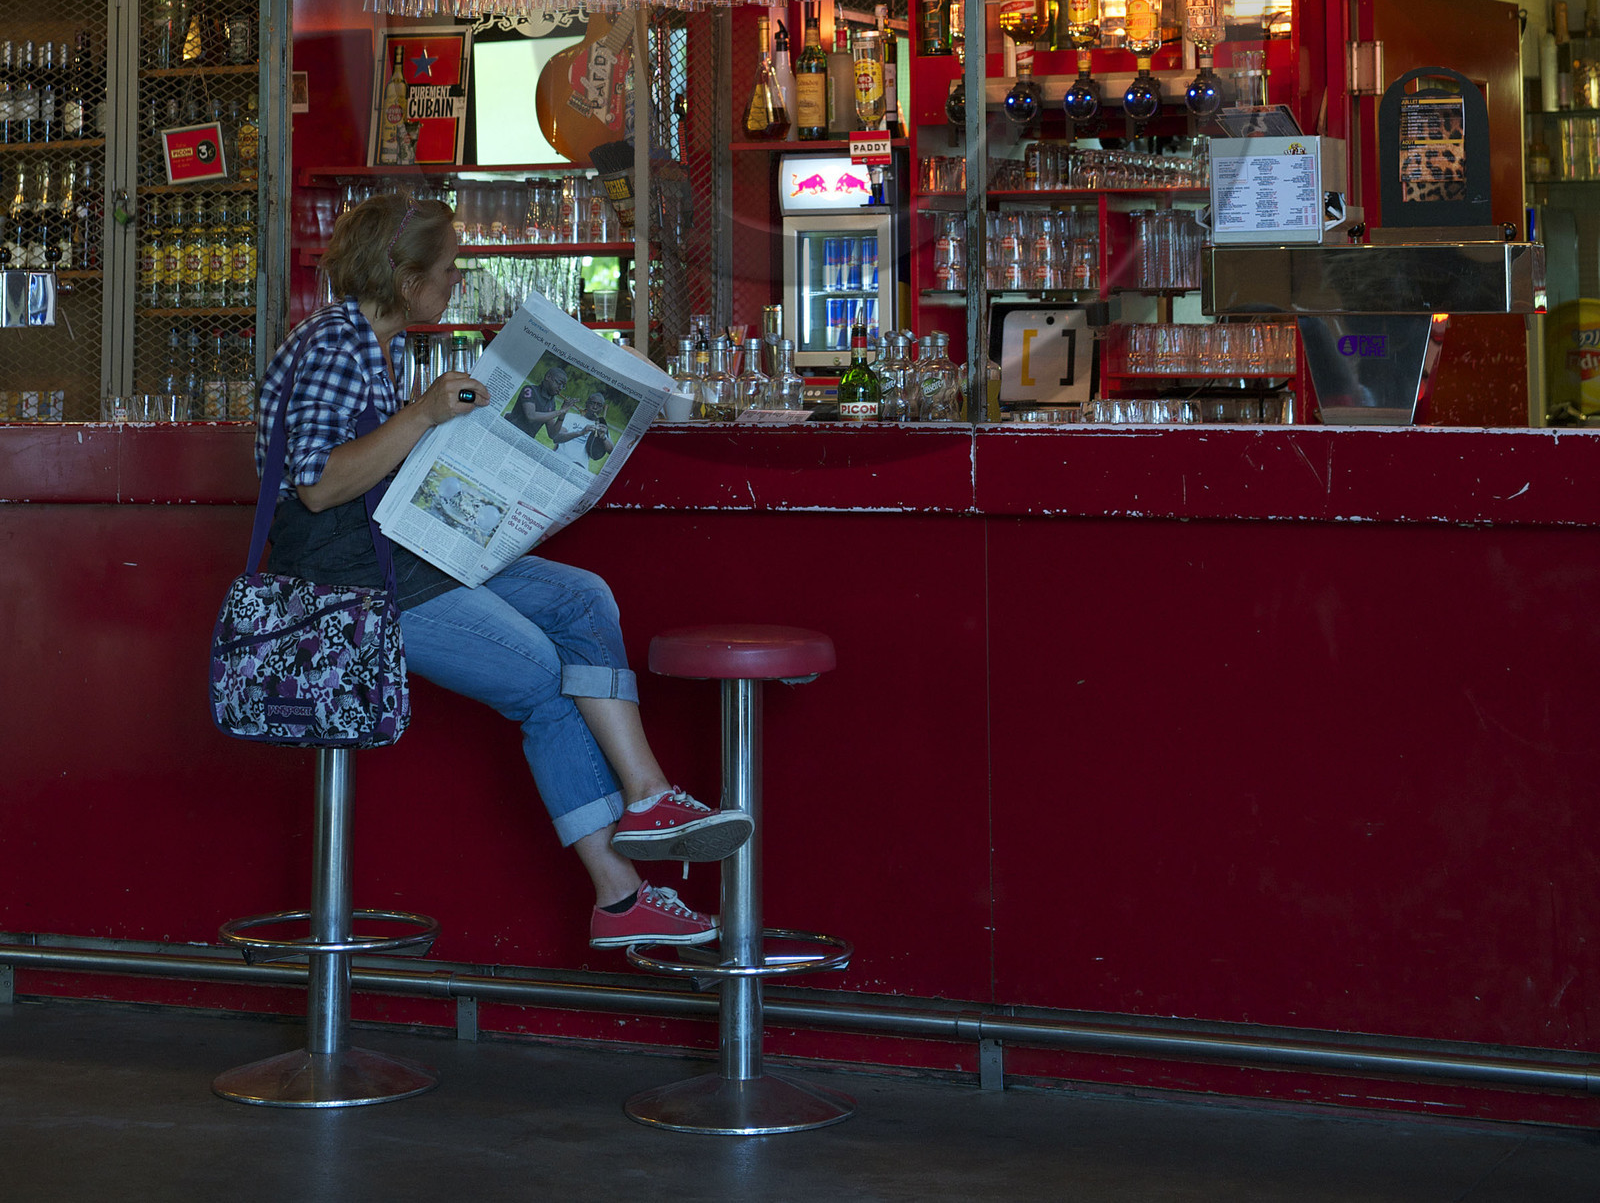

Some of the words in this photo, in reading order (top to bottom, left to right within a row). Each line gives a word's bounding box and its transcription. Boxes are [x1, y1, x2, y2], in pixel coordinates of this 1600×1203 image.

[410, 85, 451, 98] PUREMENT
[408, 98, 453, 118] CUBAIN
[853, 143, 887, 152] PADDY
[523, 325, 545, 345] Yannick
[590, 365, 611, 383] bretons
[841, 404, 877, 414] PICON
[515, 524, 528, 536] Loire
[520, 518, 533, 532] Vins
